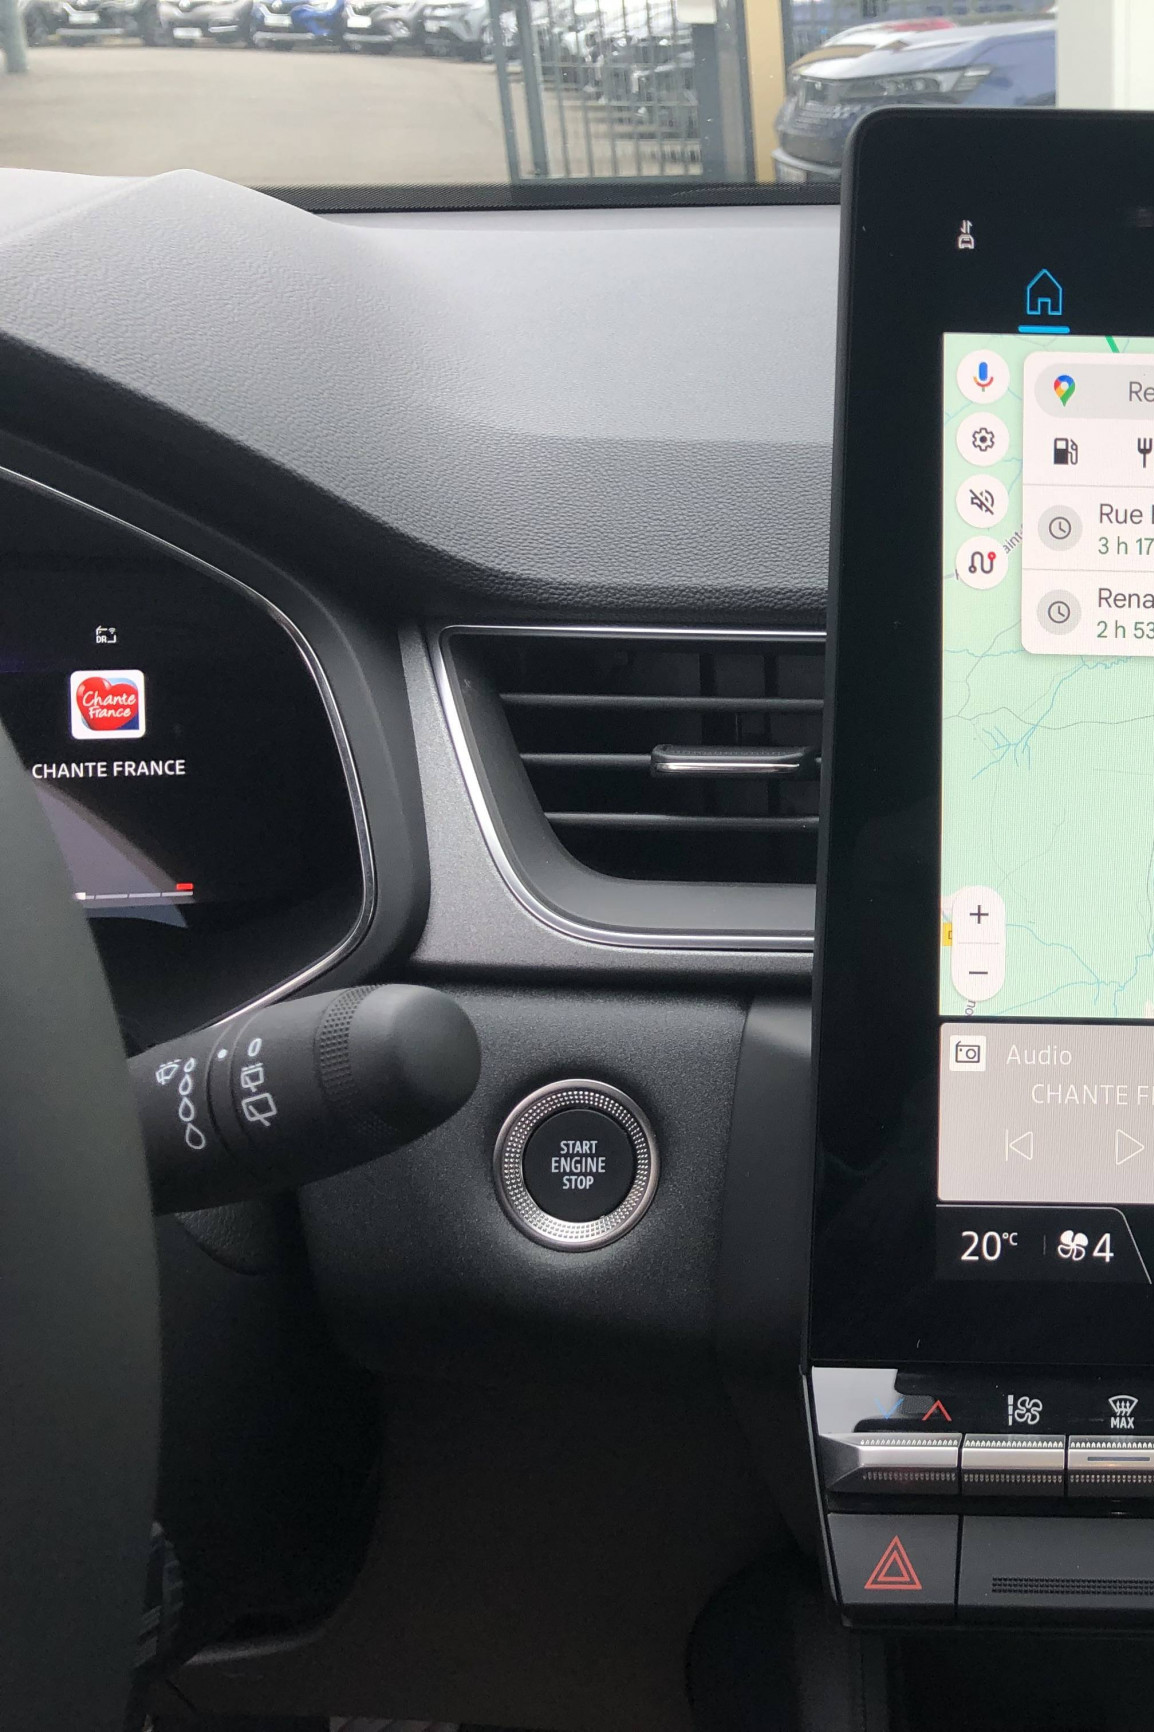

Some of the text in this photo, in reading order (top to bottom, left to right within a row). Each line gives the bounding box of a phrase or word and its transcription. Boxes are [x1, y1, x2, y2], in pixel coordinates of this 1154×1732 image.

[1099, 504, 1144, 526] Rue
[1098, 538, 1109, 555] 3
[1114, 538, 1129, 555] h
[1136, 539, 1154, 556] 17
[1097, 622, 1109, 639] 2
[1114, 621, 1127, 639] h
[82, 690, 137, 707] Chante
[88, 705, 132, 719] France
[32, 760, 187, 779] CHANTE FRANCE
[1006, 1044, 1073, 1066] Audio
[1031, 1083, 1130, 1106] CHANTE
[560, 1140, 598, 1155] START
[551, 1156, 606, 1174] ENGINE
[562, 1175, 595, 1190] STOP
[1093, 1234, 1114, 1263] 4
[1111, 1417, 1135, 1430] MAX
